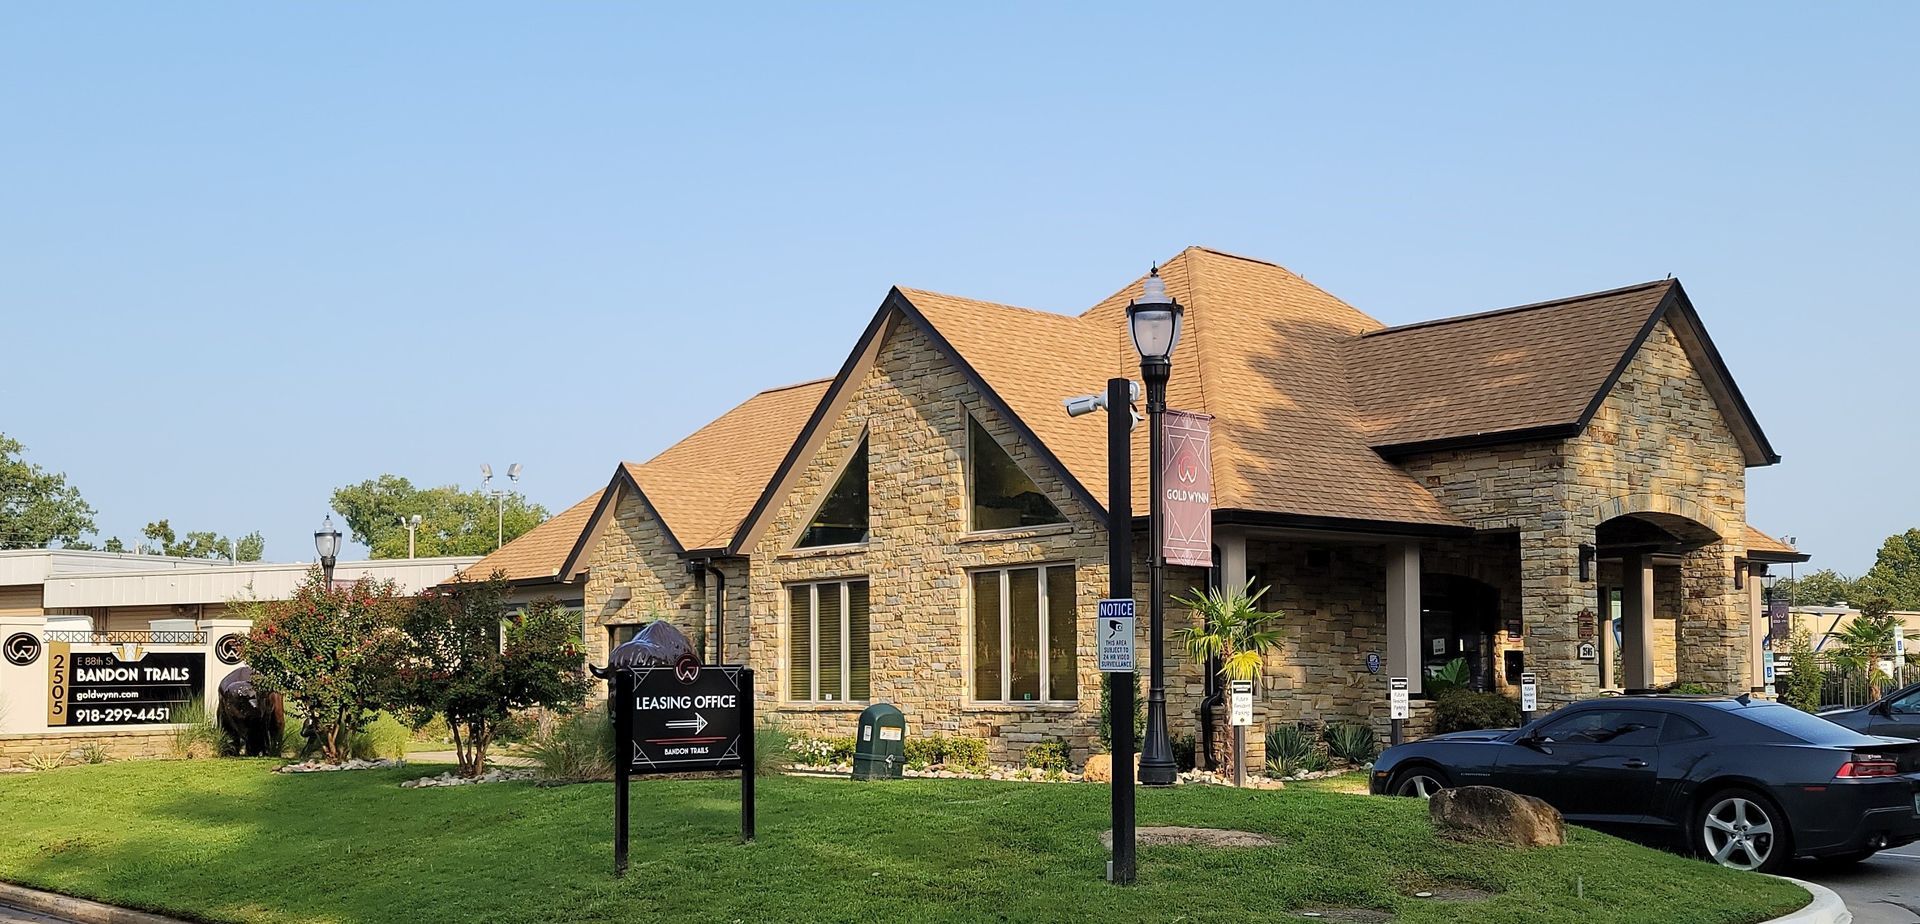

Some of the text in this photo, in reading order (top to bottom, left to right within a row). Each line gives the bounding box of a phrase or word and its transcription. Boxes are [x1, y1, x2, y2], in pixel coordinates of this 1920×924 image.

[1166, 489, 1209, 504] GOLD WYNN
[1100, 603, 1133, 616] NOTICE
[77, 656, 115, 666] E 88th St
[76, 667, 190, 682] BANDON TRAILS
[52, 654, 65, 715] 2505
[76, 689, 139, 702] goldwynn.com
[636, 695, 736, 710] LEASING OFFICE
[75, 706, 170, 722] 918-299-4451
[664, 746, 709, 756] BANDON TRAILS
